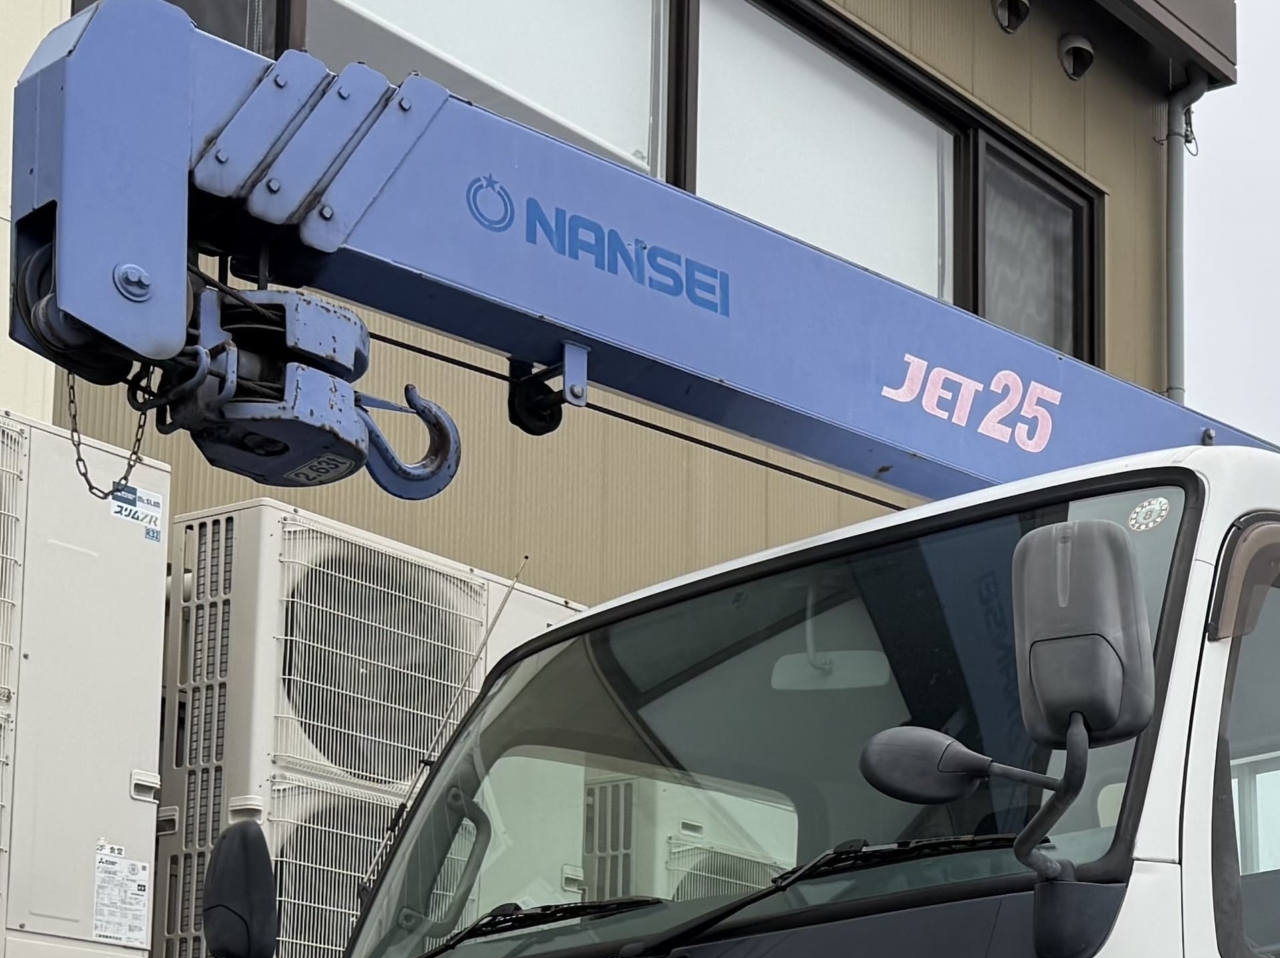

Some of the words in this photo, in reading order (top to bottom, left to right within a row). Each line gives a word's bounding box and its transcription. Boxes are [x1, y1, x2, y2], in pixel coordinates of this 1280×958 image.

[525, 197, 730, 318] NANSEI
[881, 353, 984, 427] JET
[977, 369, 1063, 453] 25
